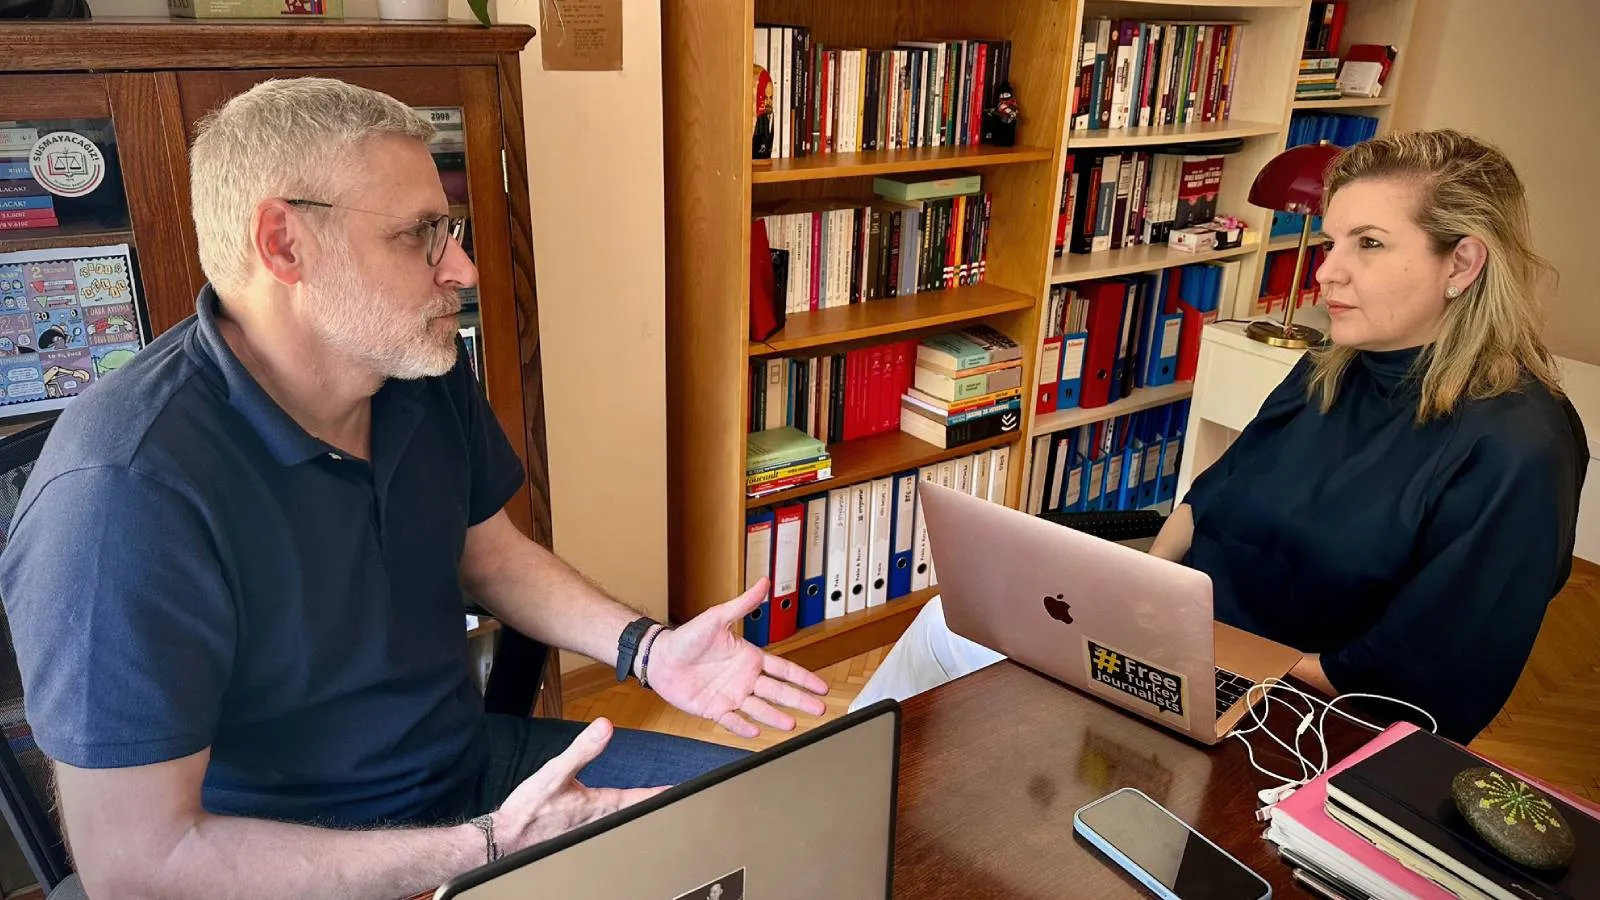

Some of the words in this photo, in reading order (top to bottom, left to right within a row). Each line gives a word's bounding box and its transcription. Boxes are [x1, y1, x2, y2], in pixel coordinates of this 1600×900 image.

[33, 135, 100, 162] SUSMAYACAĞIZ!
[1093, 646, 1177, 691] #Free
[1096, 670, 1180, 713] Journalists
[1125, 672, 1179, 702] Turkey
